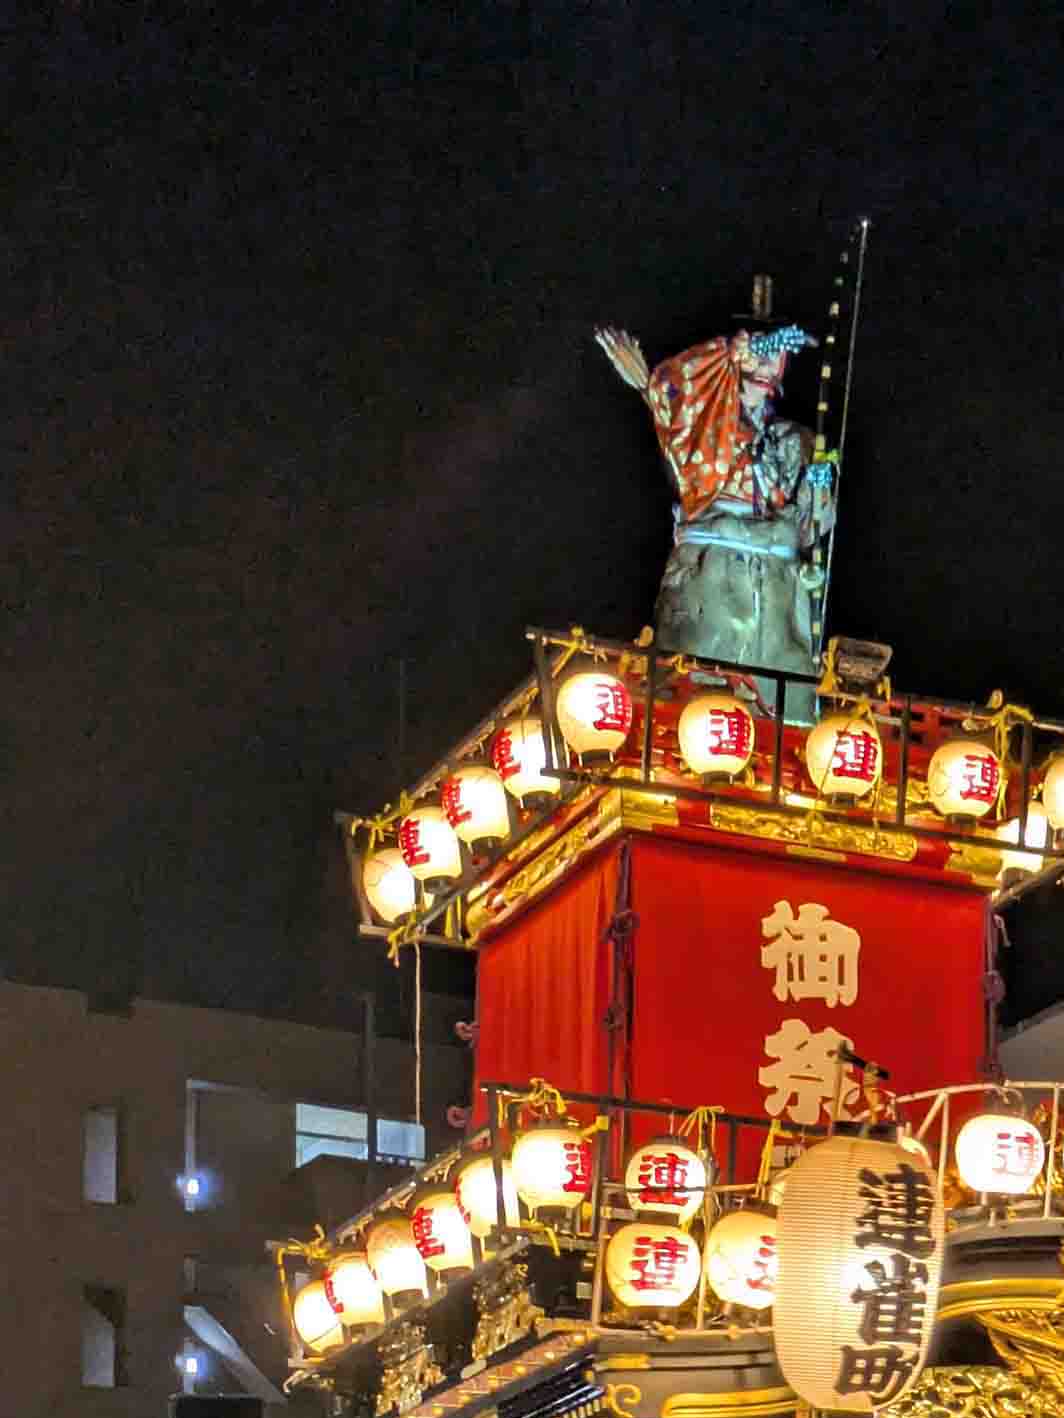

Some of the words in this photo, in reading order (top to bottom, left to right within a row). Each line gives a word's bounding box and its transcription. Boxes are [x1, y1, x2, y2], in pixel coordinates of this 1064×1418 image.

[709, 706, 752, 760] 連
[832, 729, 879, 781] 連
[960, 753, 1000, 804] 連
[638, 1152, 689, 1206] 連
[631, 1235, 689, 1291] 連
